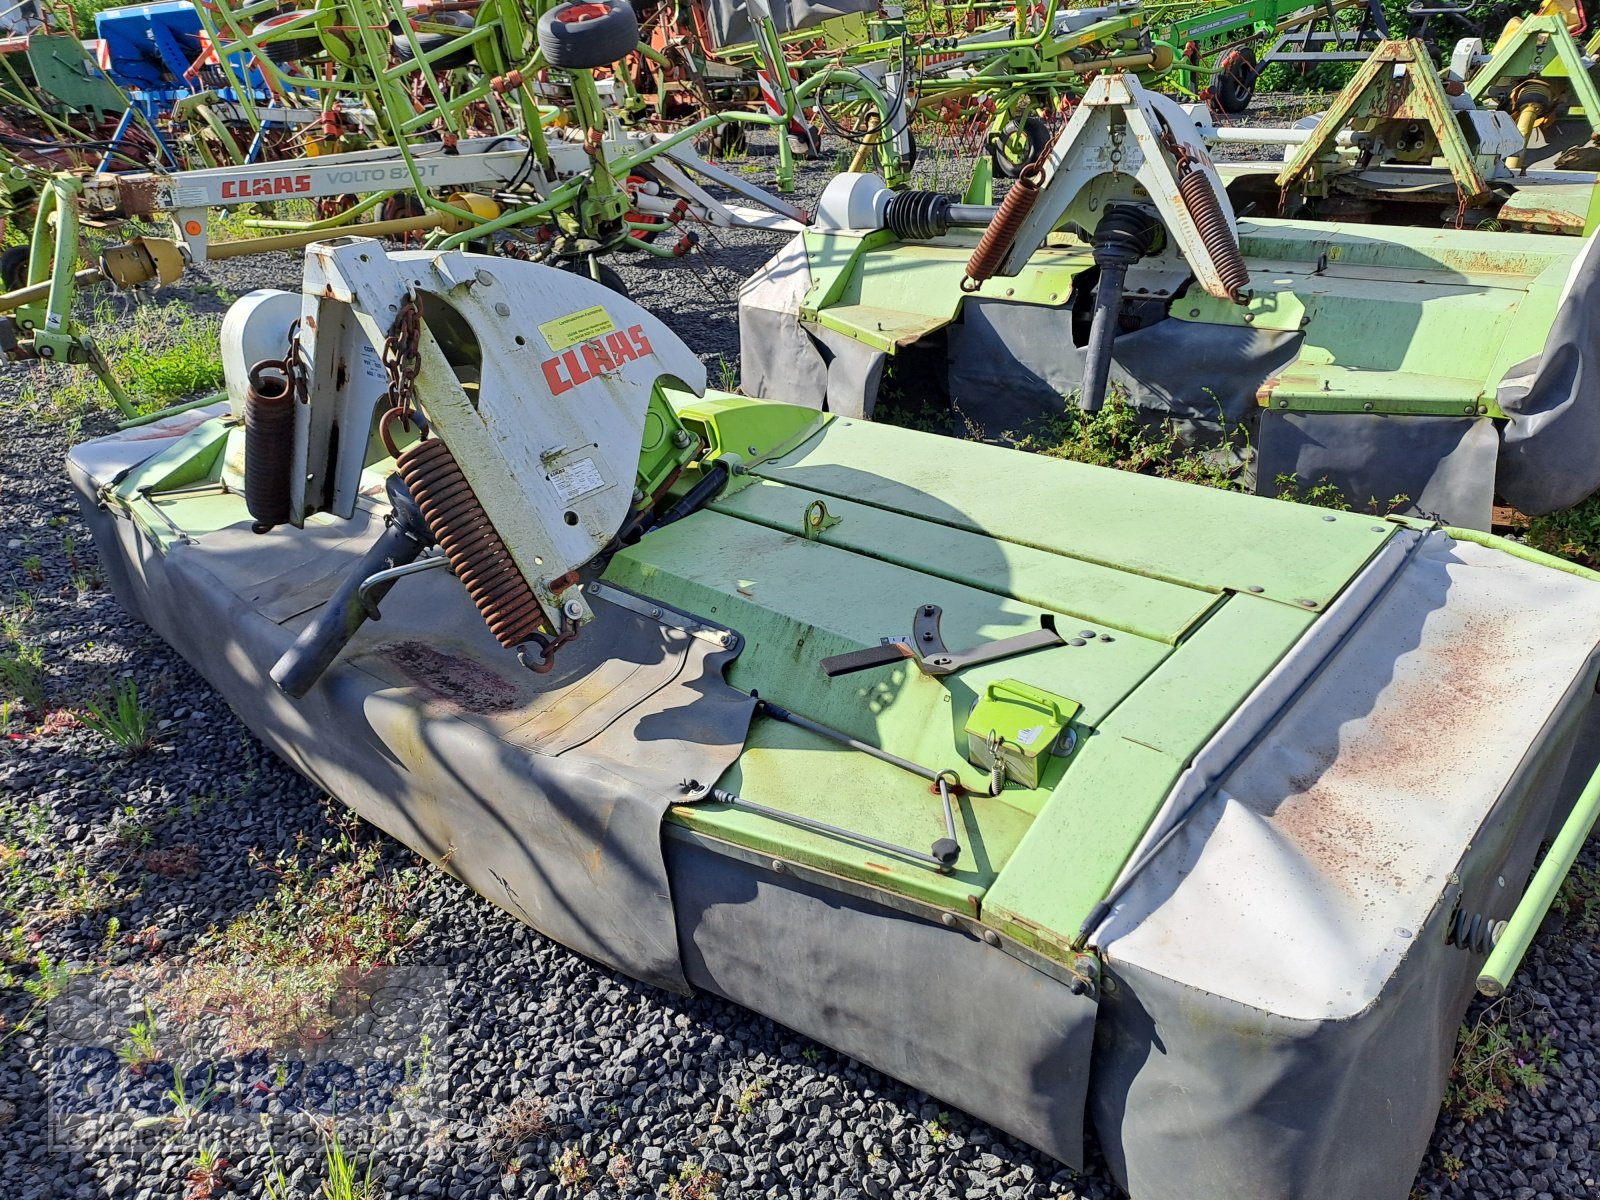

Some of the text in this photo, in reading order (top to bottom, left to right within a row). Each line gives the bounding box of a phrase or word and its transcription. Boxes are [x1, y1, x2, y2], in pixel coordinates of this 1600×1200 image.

[221, 175, 311, 199] CLAAS
[326, 169, 385, 184] VOLTO
[428, 164, 439, 177] T
[540, 324, 653, 396] CLAAS
